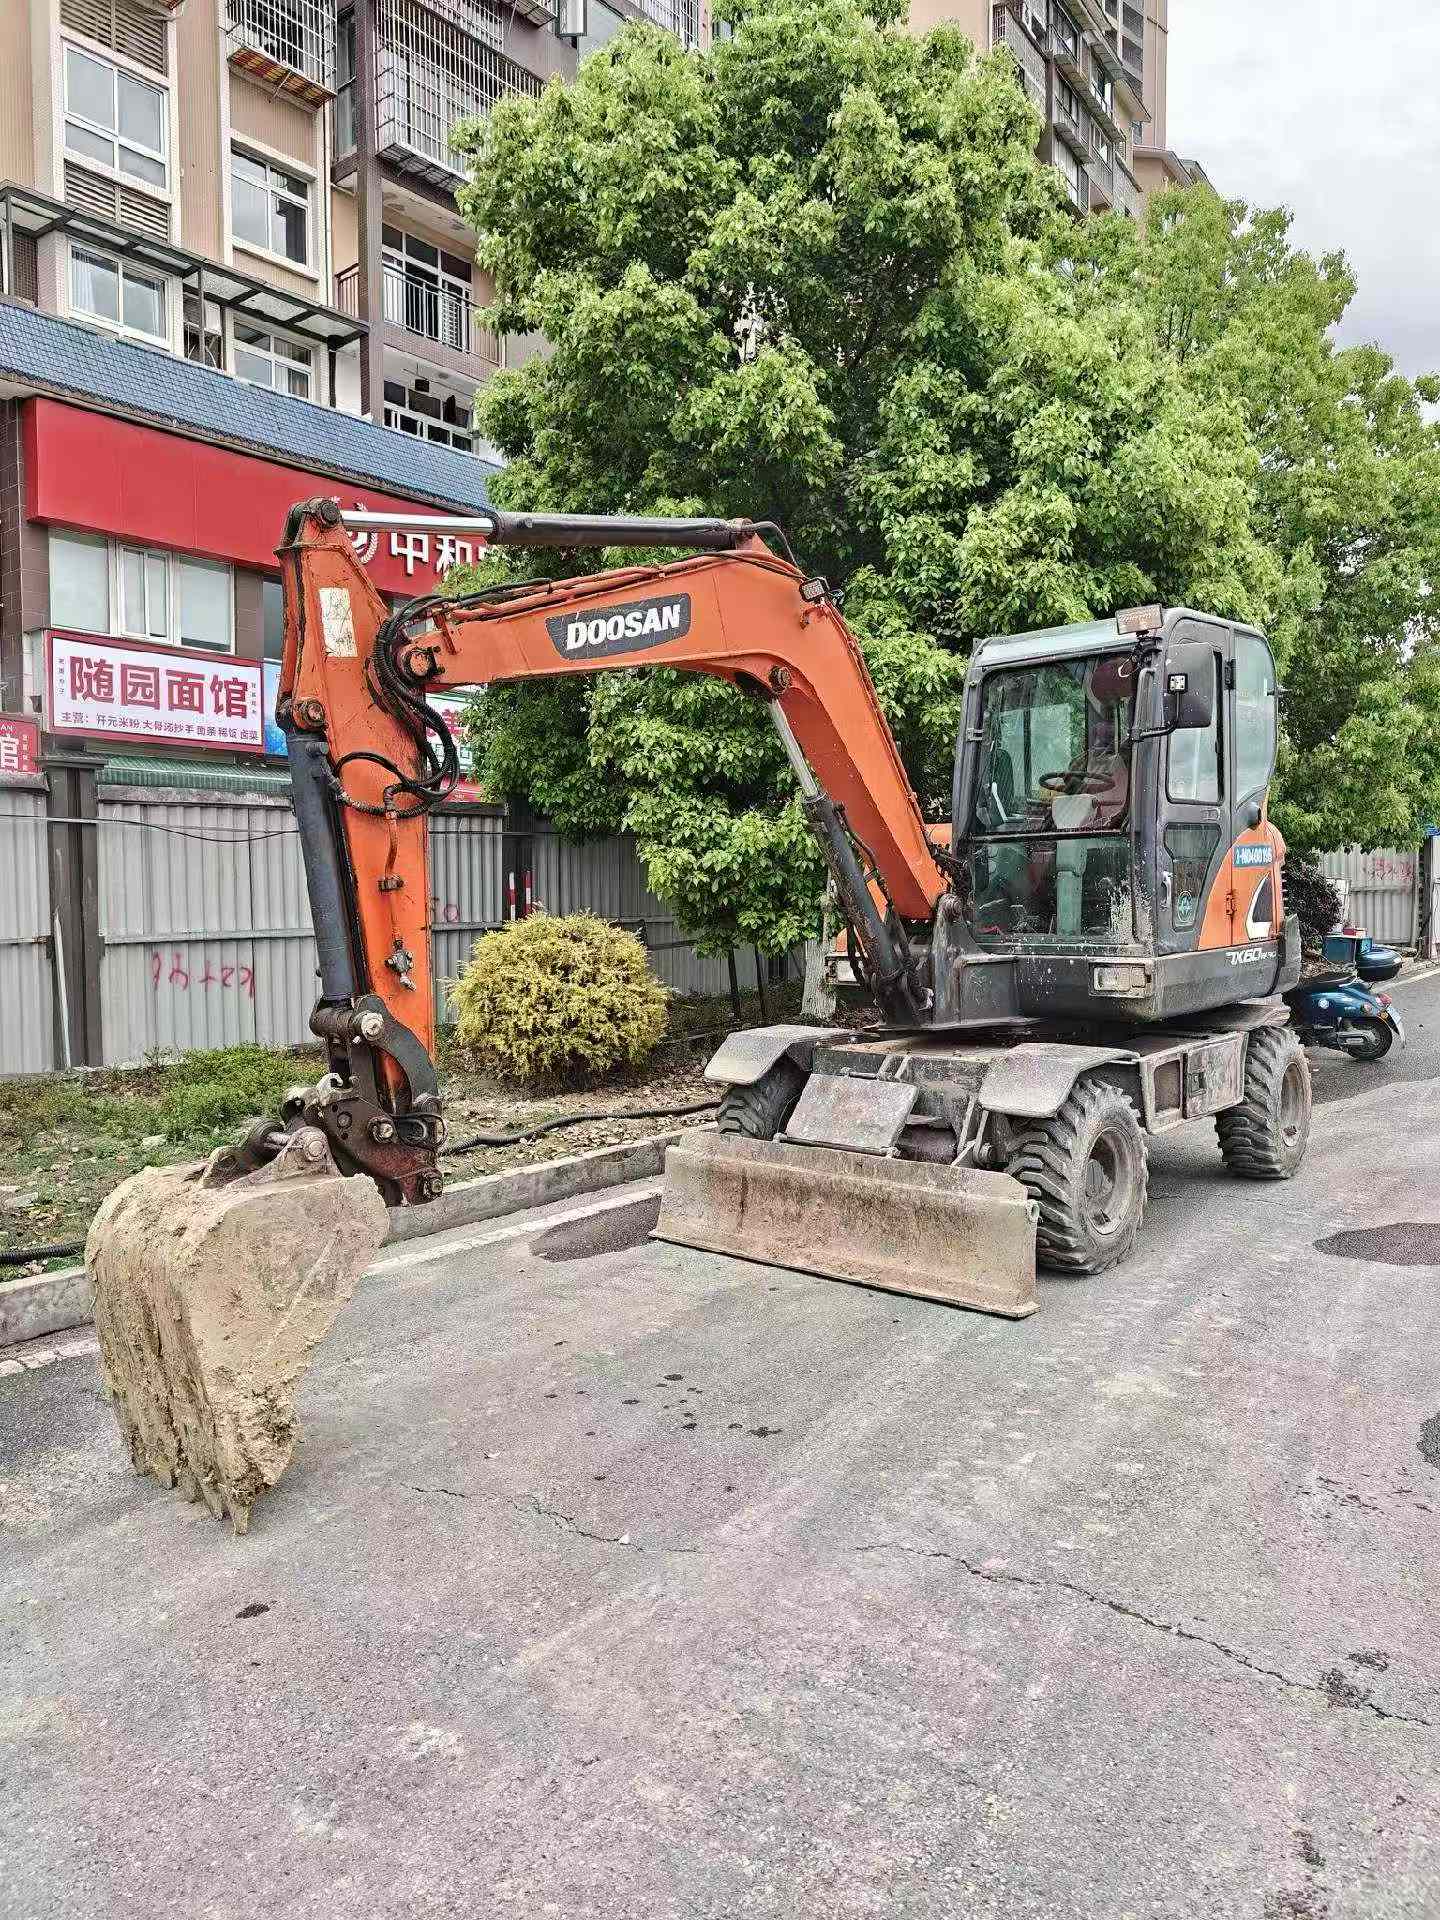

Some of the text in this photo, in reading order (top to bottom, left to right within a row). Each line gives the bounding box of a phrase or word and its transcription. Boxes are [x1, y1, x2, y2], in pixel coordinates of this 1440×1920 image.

[566, 604, 681, 650] DOOSAN
[69, 656, 248, 719] 随园面馆
